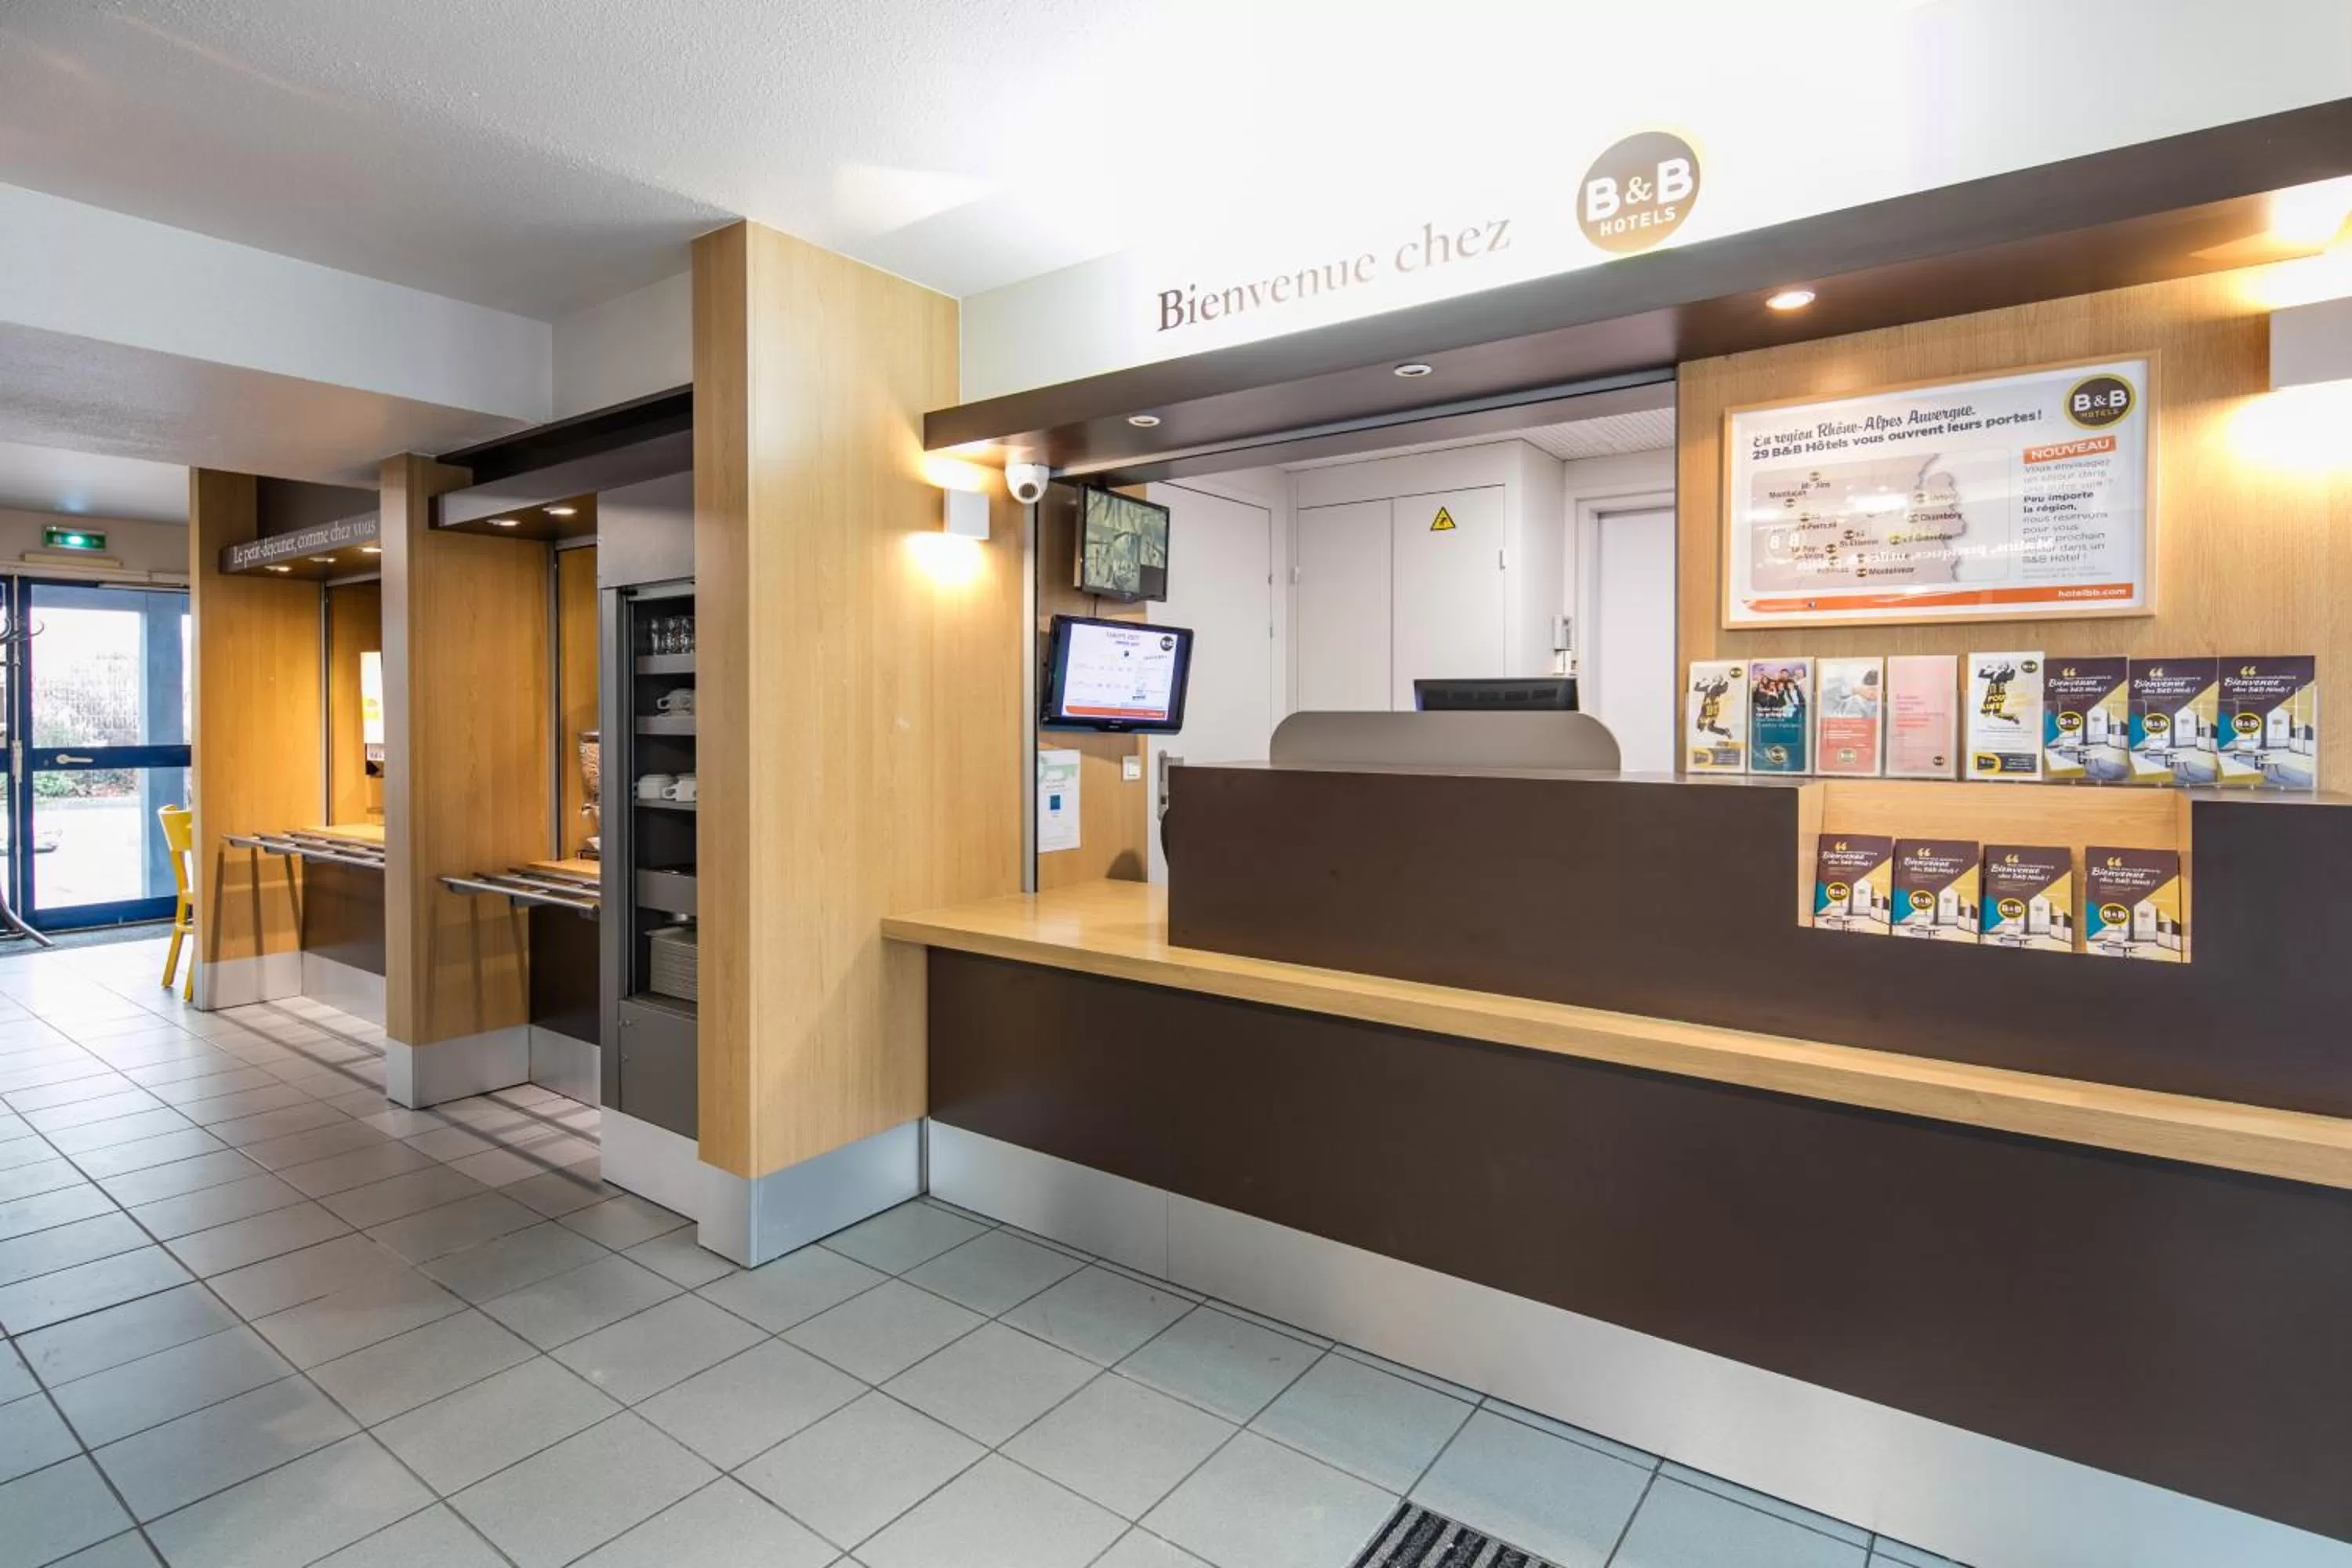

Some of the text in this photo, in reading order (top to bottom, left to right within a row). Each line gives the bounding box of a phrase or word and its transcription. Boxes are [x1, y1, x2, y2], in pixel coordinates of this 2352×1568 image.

[1586, 158, 1693, 223] B&B
[1600, 206, 1676, 237] HOTELS
[1156, 217, 1512, 332] Bienvenue chez
[1752, 450, 1769, 460] 29
[1772, 445, 1802, 457] B&B
[1806, 439, 1848, 452] Hôtels
[1853, 433, 1884, 445] vous
[1888, 424, 1944, 441] ouvrent
[1947, 419, 1982, 433] leurs
[2031, 439, 2110, 459] NOUVEAU
[2048, 492, 2094, 502] importe
[233, 546, 243, 564] Le
[297, 530, 329, 549] comme
[330, 520, 351, 543] chez
[354, 520, 376, 536] vous
